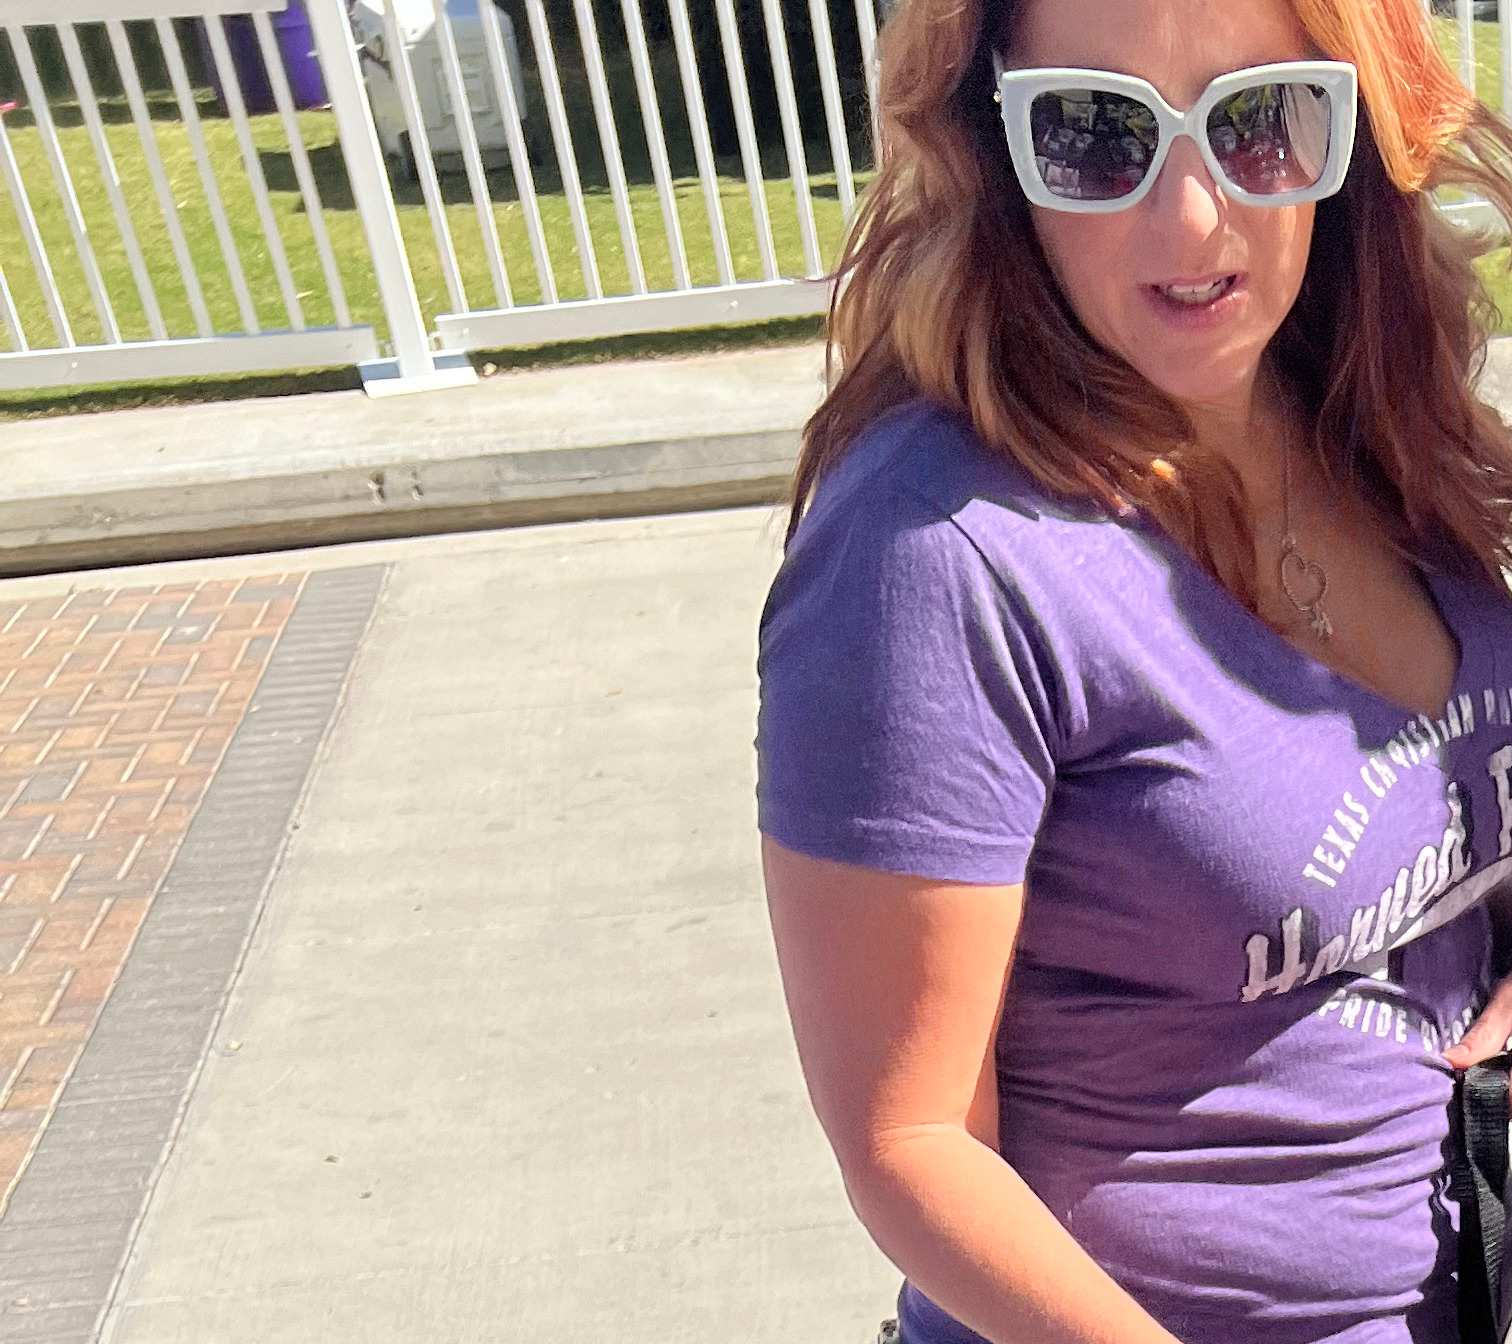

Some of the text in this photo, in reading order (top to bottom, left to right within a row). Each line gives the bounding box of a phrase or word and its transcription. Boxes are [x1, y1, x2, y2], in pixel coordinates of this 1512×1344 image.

[1303, 792, 1370, 888] TEXAS
[1360, 693, 1475, 799] CHRISTIAN
[1318, 990, 1408, 1044] PRIDE
